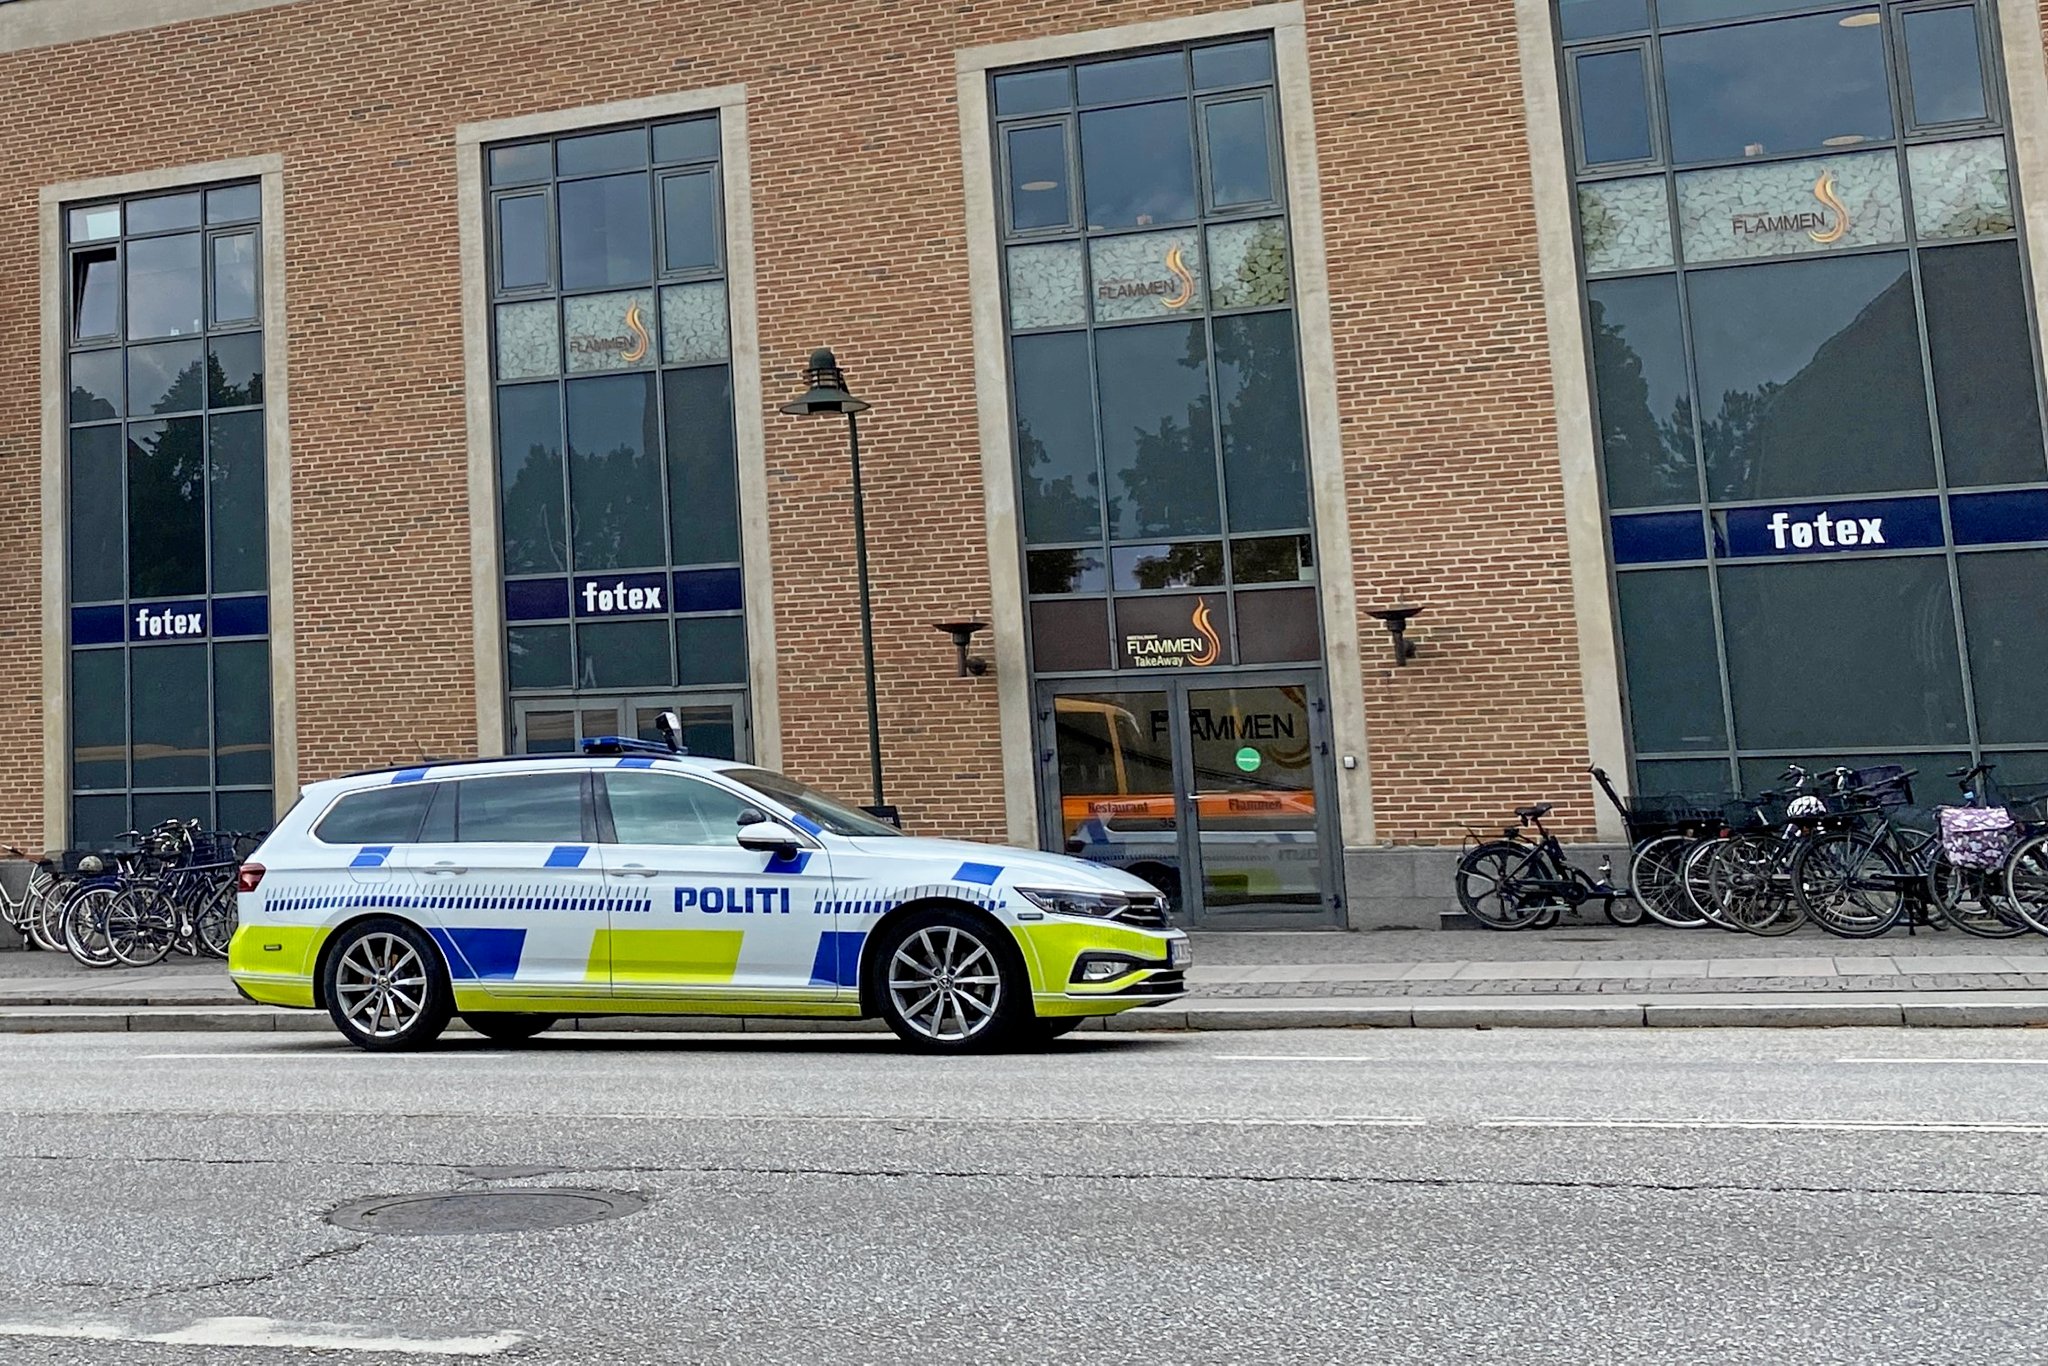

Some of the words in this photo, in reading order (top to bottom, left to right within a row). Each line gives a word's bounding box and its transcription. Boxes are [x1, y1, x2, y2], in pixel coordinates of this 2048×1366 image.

[1732, 212, 1825, 235] FLAMMEN
[1098, 280, 1175, 299] FLAMMEN
[1766, 511, 1886, 549] føtex
[582, 581, 662, 612] føtex
[135, 608, 202, 637] føtex
[1127, 638, 1203, 655] FLAMMEN
[1133, 655, 1184, 668] TakeAway
[1151, 713, 1295, 742] FAMMEN
[1088, 802, 1149, 814] Restaurant
[1228, 799, 1283, 811] Flammen
[674, 886, 790, 914] POLITI
